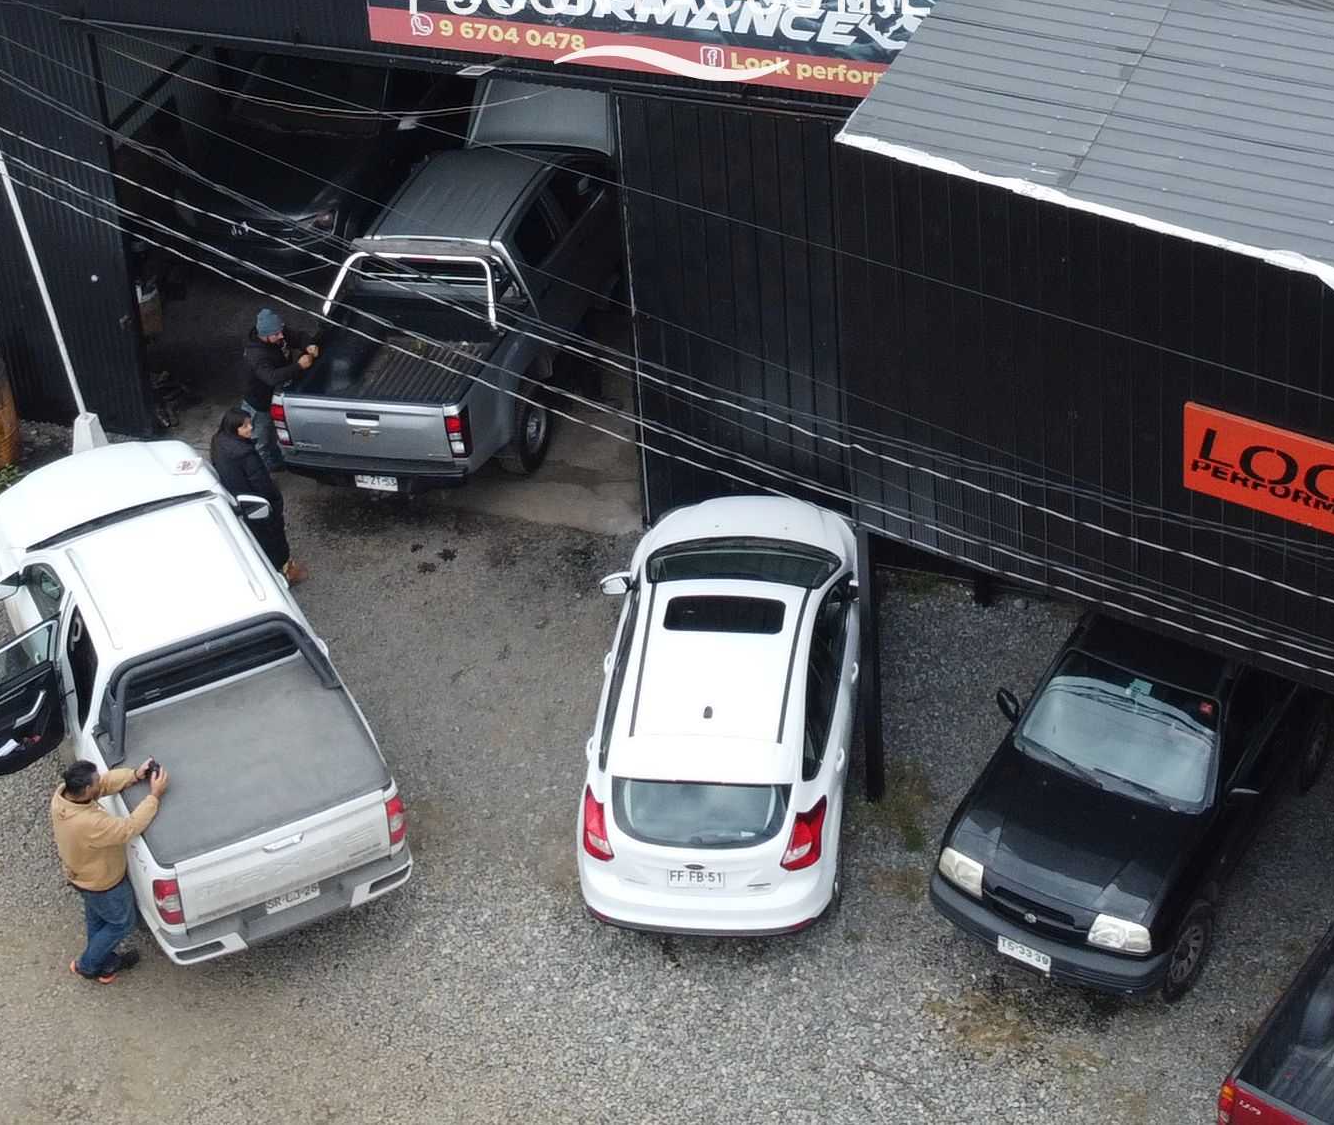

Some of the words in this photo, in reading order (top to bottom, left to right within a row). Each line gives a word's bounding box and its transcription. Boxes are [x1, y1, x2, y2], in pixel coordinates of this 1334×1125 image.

[439, 19, 454, 37] 9
[460, 22, 520, 44] 6704
[526, 29, 586, 51] 0478
[731, 51, 791, 76] Look
